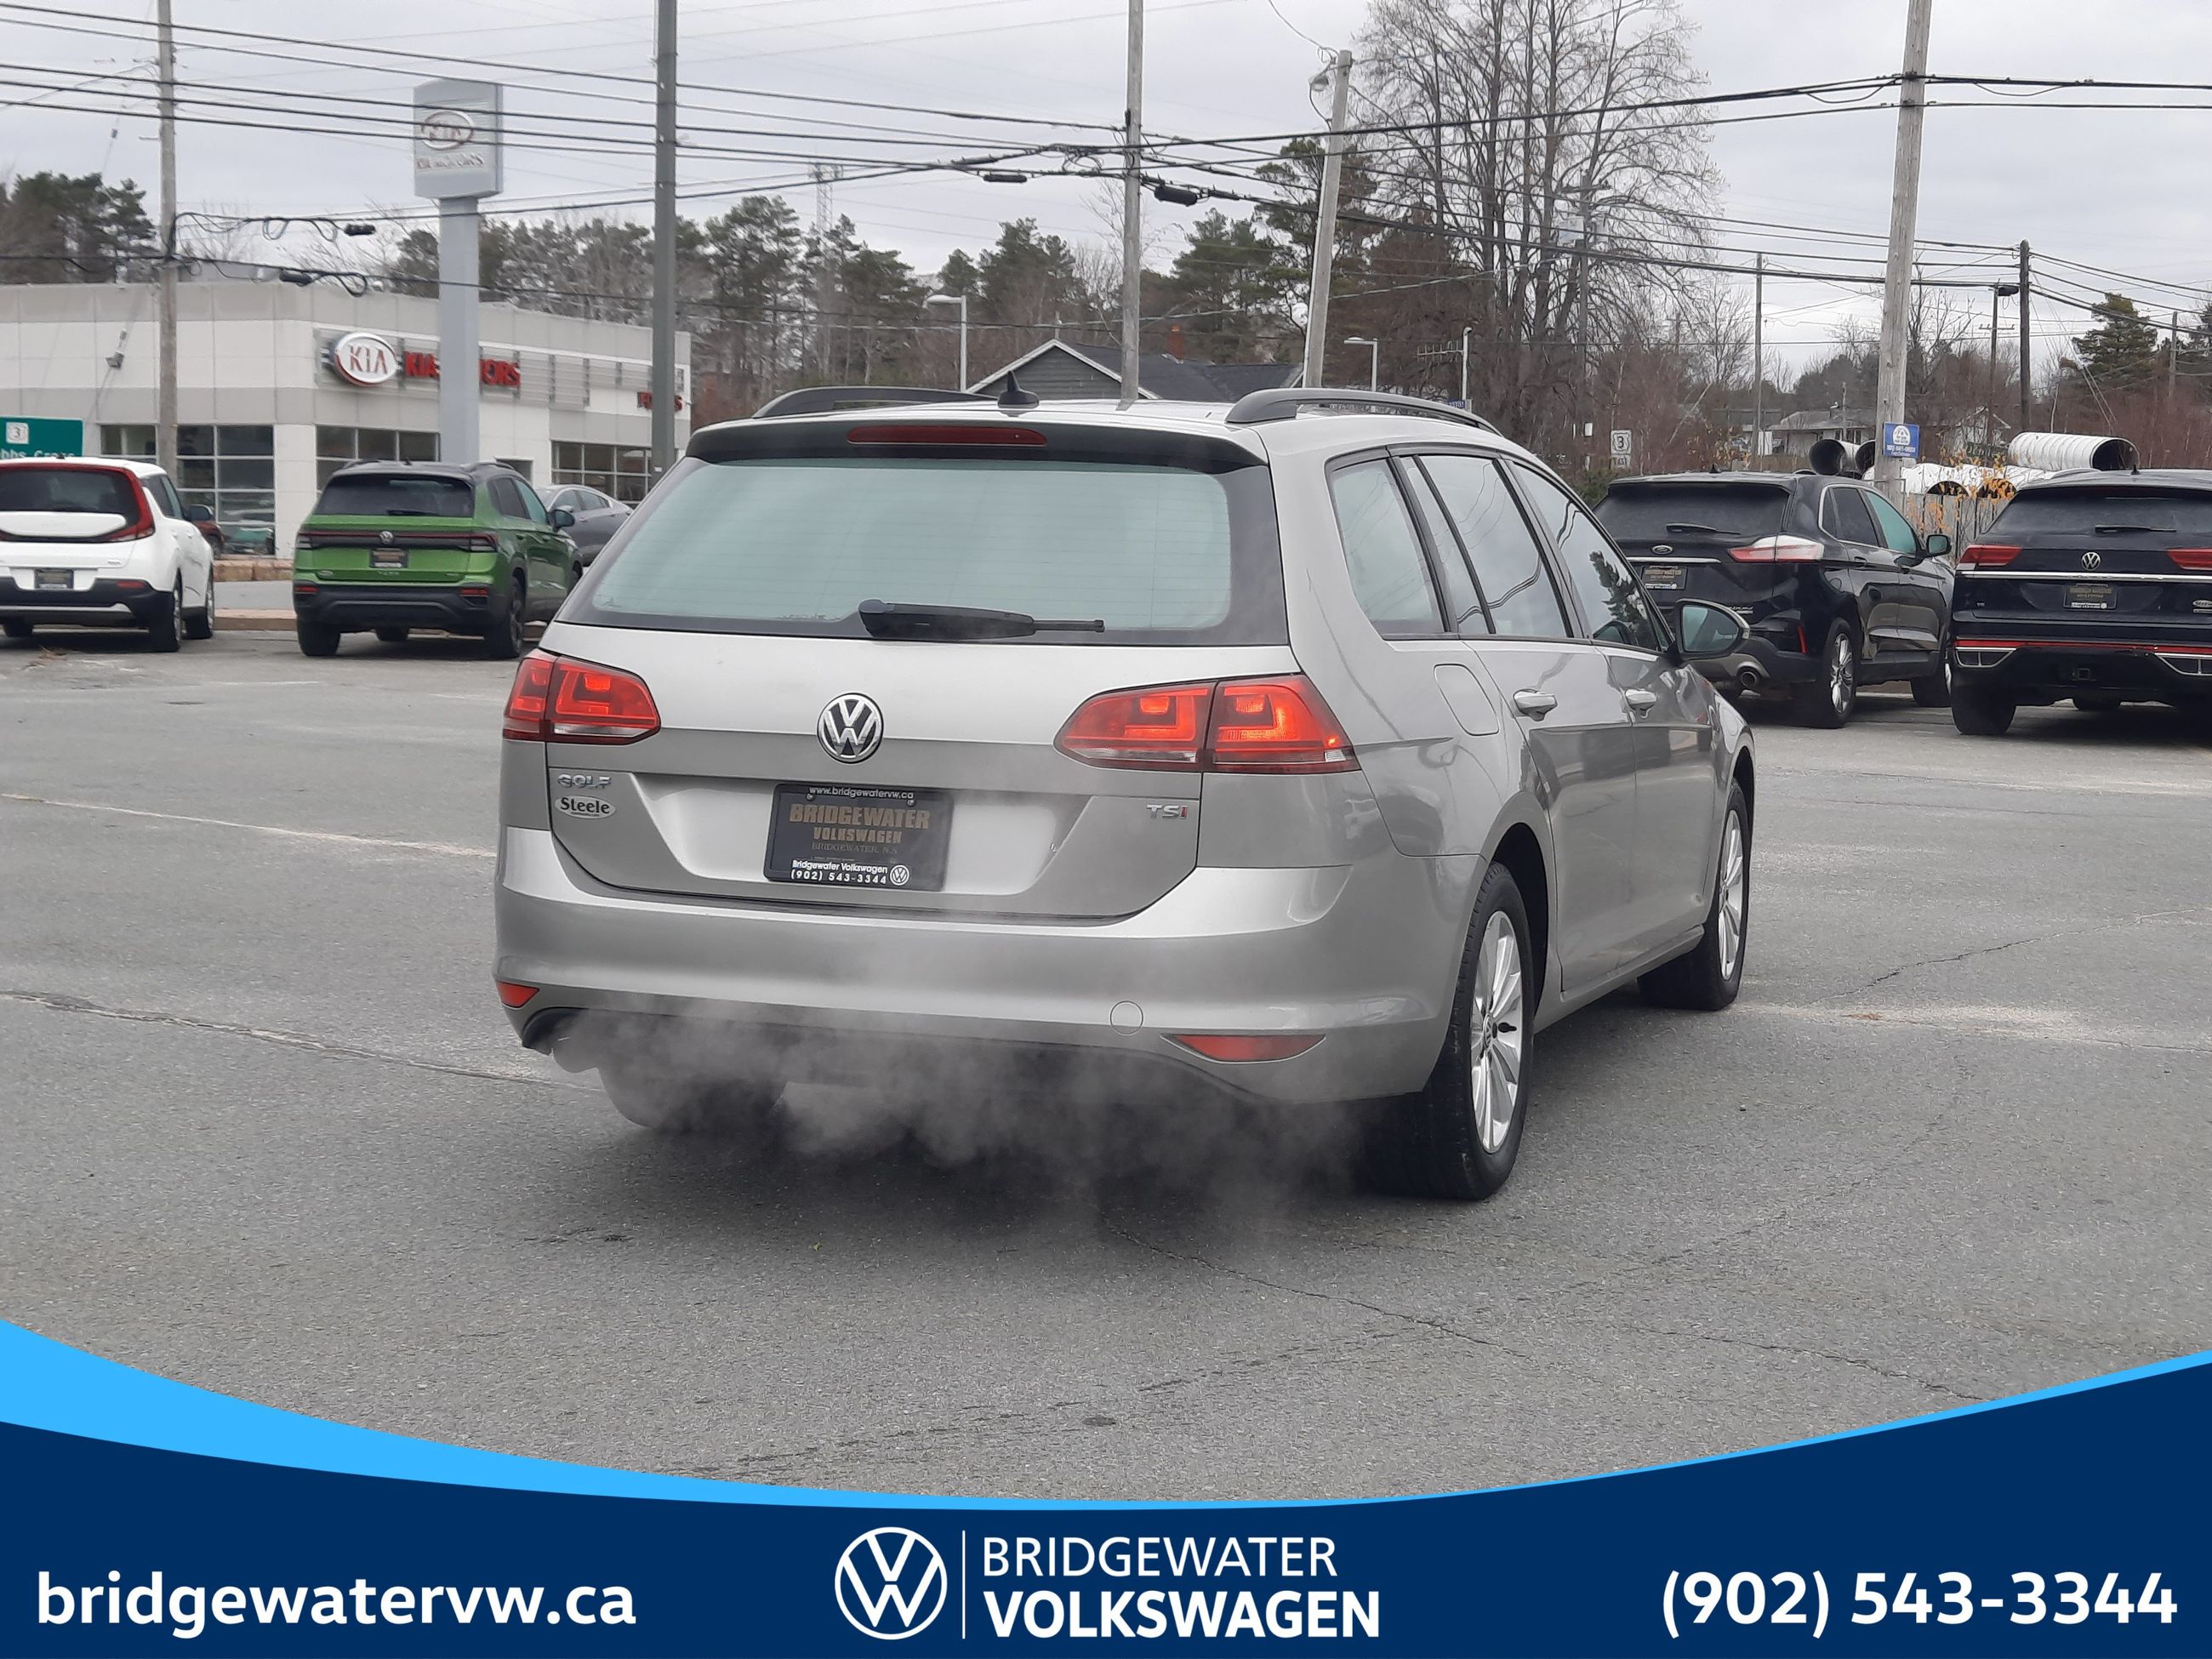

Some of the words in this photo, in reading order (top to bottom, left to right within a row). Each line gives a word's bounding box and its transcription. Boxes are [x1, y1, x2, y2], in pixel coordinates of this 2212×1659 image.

[347, 344, 389, 374] KIA
[14, 426, 21, 438] 3
[1616, 436, 1624, 448] 3
[557, 772, 612, 789] GOLF
[809, 786, 914, 800] www.bridgewatervw.ca
[560, 796, 611, 814] Steele
[789, 802, 931, 830] BRIDGEWATER
[812, 826, 903, 844] VOLKSWAGEN
[792, 859, 840, 871] Bridgewater
[841, 862, 888, 875] Volkswagen
[791, 869, 823, 881] (902)
[828, 871, 887, 885] 543-3344
